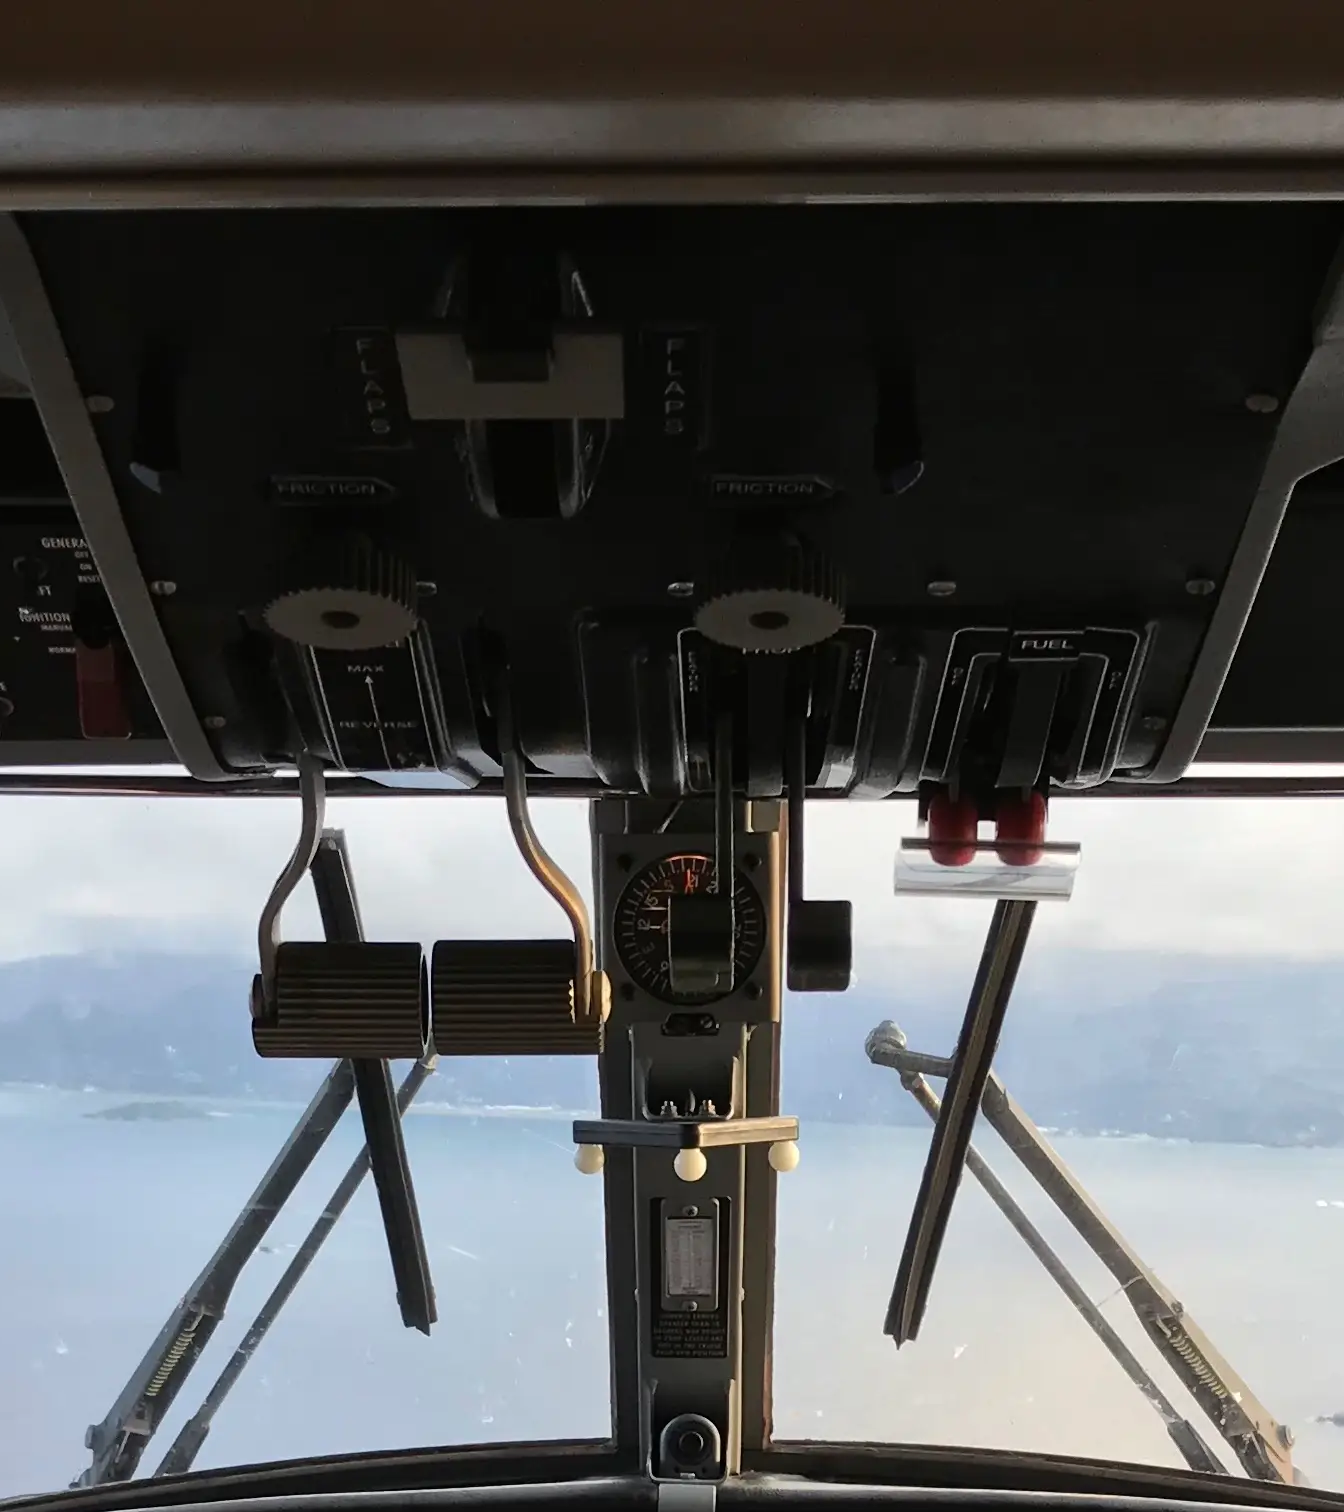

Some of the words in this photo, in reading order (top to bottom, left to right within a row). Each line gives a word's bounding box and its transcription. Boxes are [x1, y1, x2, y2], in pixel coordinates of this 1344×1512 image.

[355, 337, 391, 435] FLAPS
[664, 337, 686, 435] FLAPS
[276, 482, 377, 496] FRICTION
[714, 482, 815, 496] FRICTION
[1020, 639, 1074, 650] FUEL
[347, 665, 385, 673] MAX
